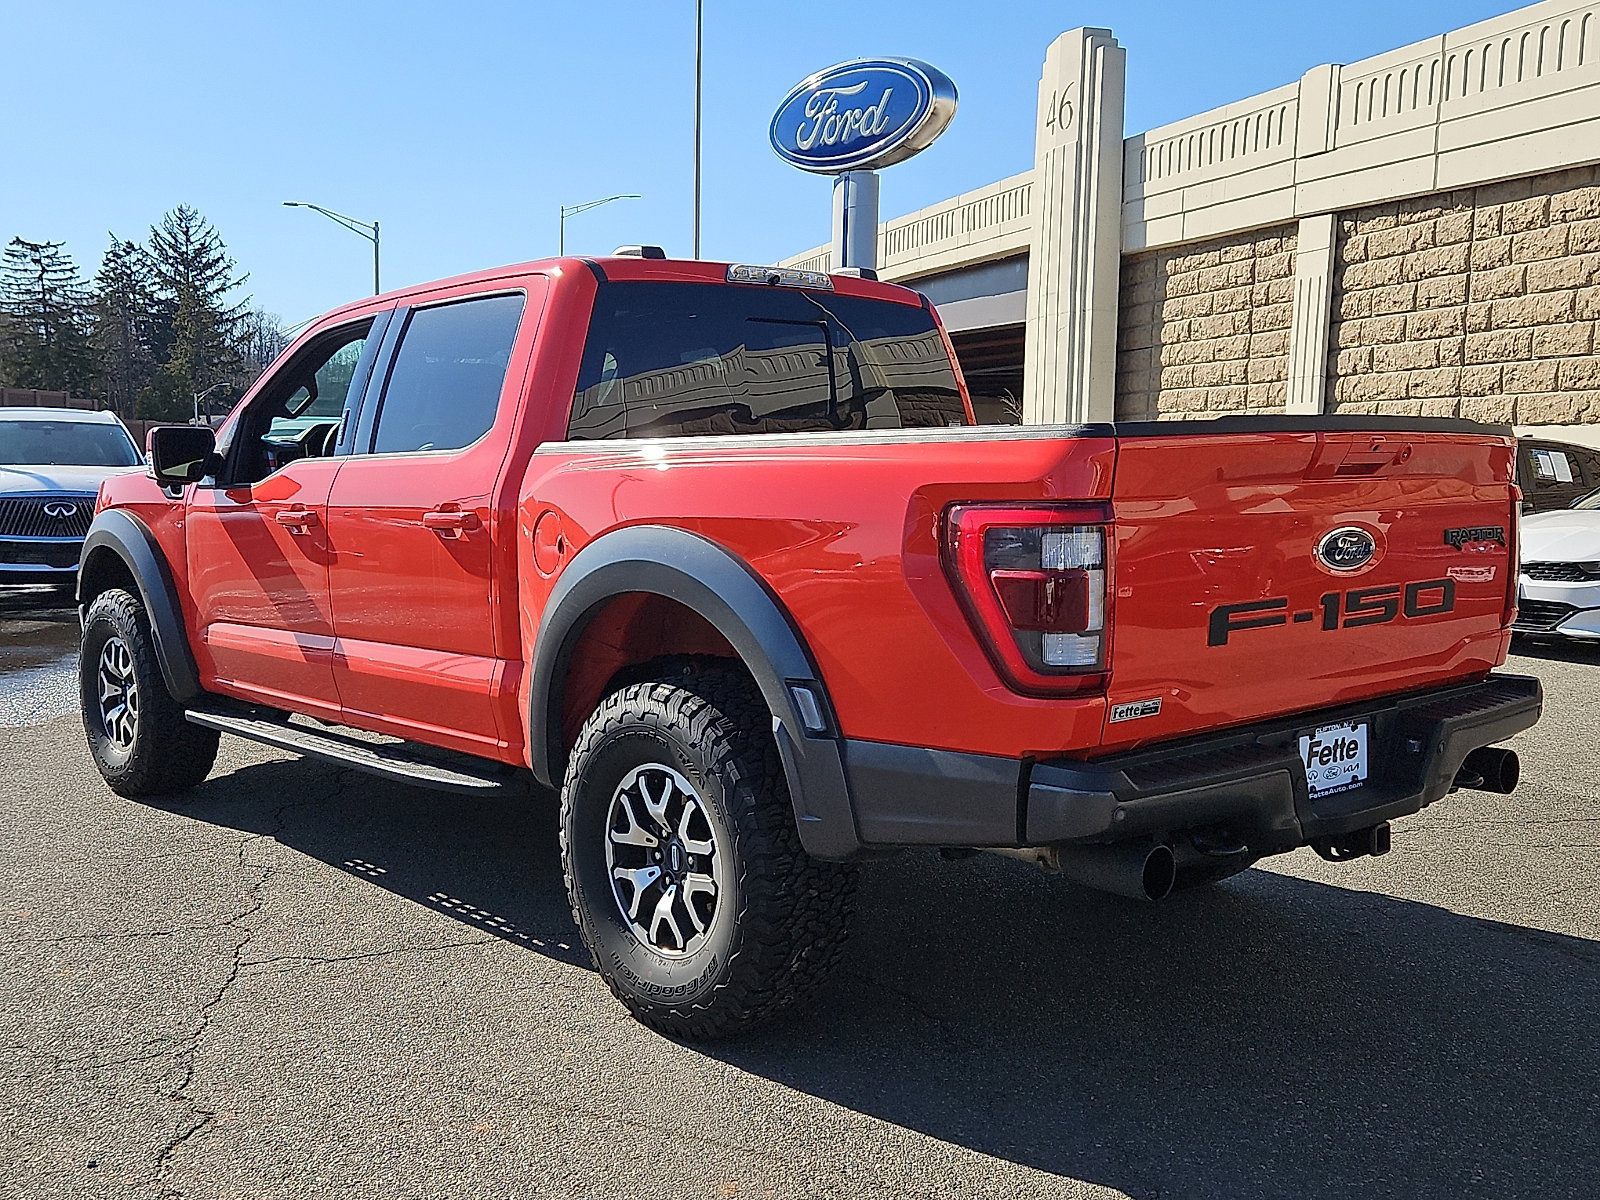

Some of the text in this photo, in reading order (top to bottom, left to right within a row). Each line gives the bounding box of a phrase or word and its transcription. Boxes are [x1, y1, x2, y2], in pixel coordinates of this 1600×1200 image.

[796, 80, 893, 151] Ford
[1045, 81, 1075, 136] 46
[1335, 536, 1366, 560] Ford
[1447, 527, 1506, 551] RAPTOR
[1207, 578, 1456, 647] F-150
[1113, 705, 1140, 719] Fette
[1307, 737, 1359, 769] Fette
[1308, 782, 1363, 799] FetteAuto.com
